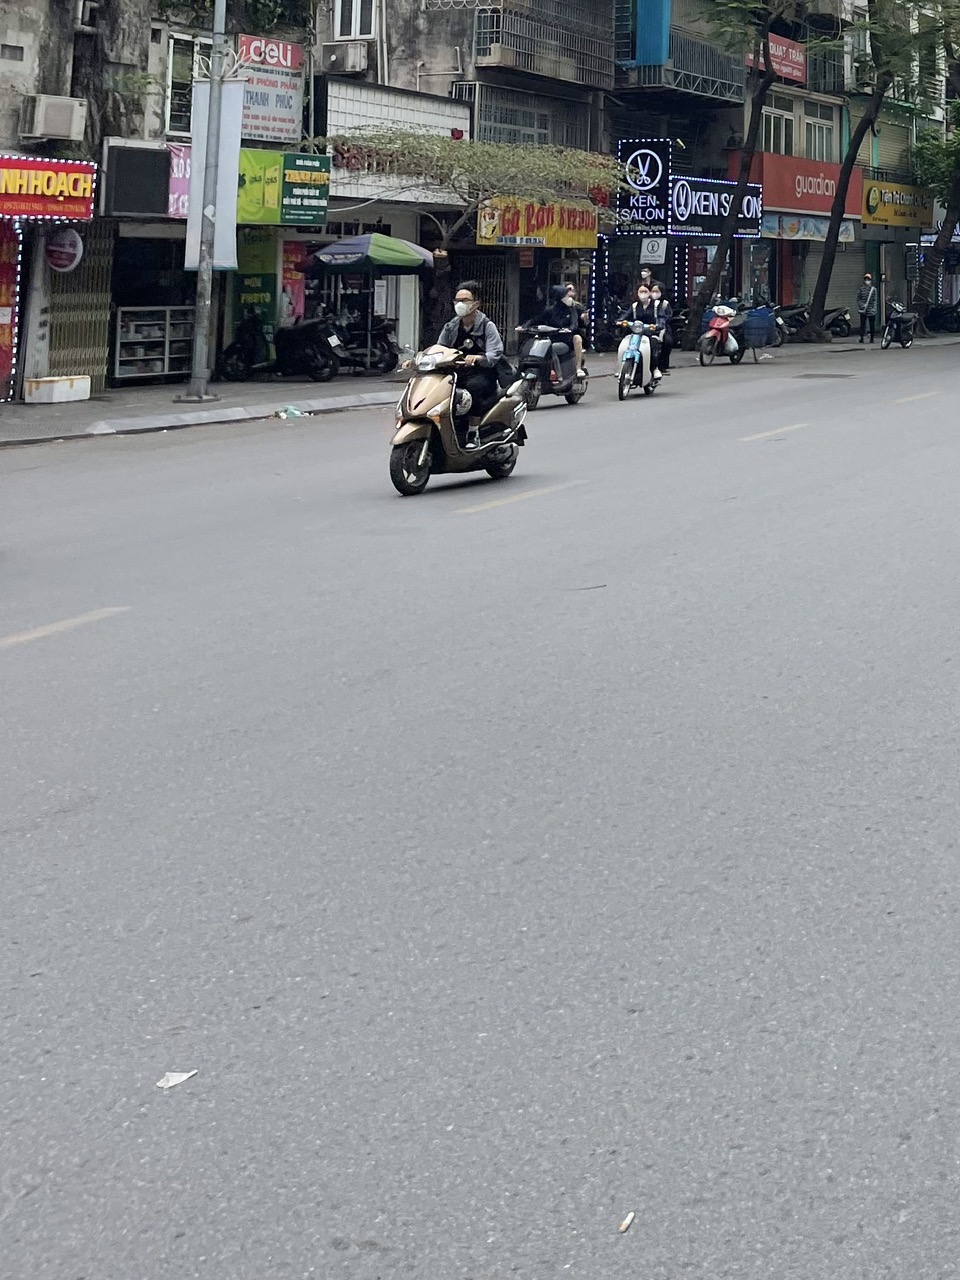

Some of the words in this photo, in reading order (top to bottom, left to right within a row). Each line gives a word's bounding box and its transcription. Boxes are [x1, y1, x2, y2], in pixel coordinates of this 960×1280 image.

[250, 40, 291, 67] deli
[245, 90, 270, 107] THANH
[275, 91, 293, 110] PHÚC
[795, 172, 836, 198] guardian
[629, 195, 657, 207] KEN
[691, 191, 719, 215] KEN
[620, 208, 665, 220] SALON
